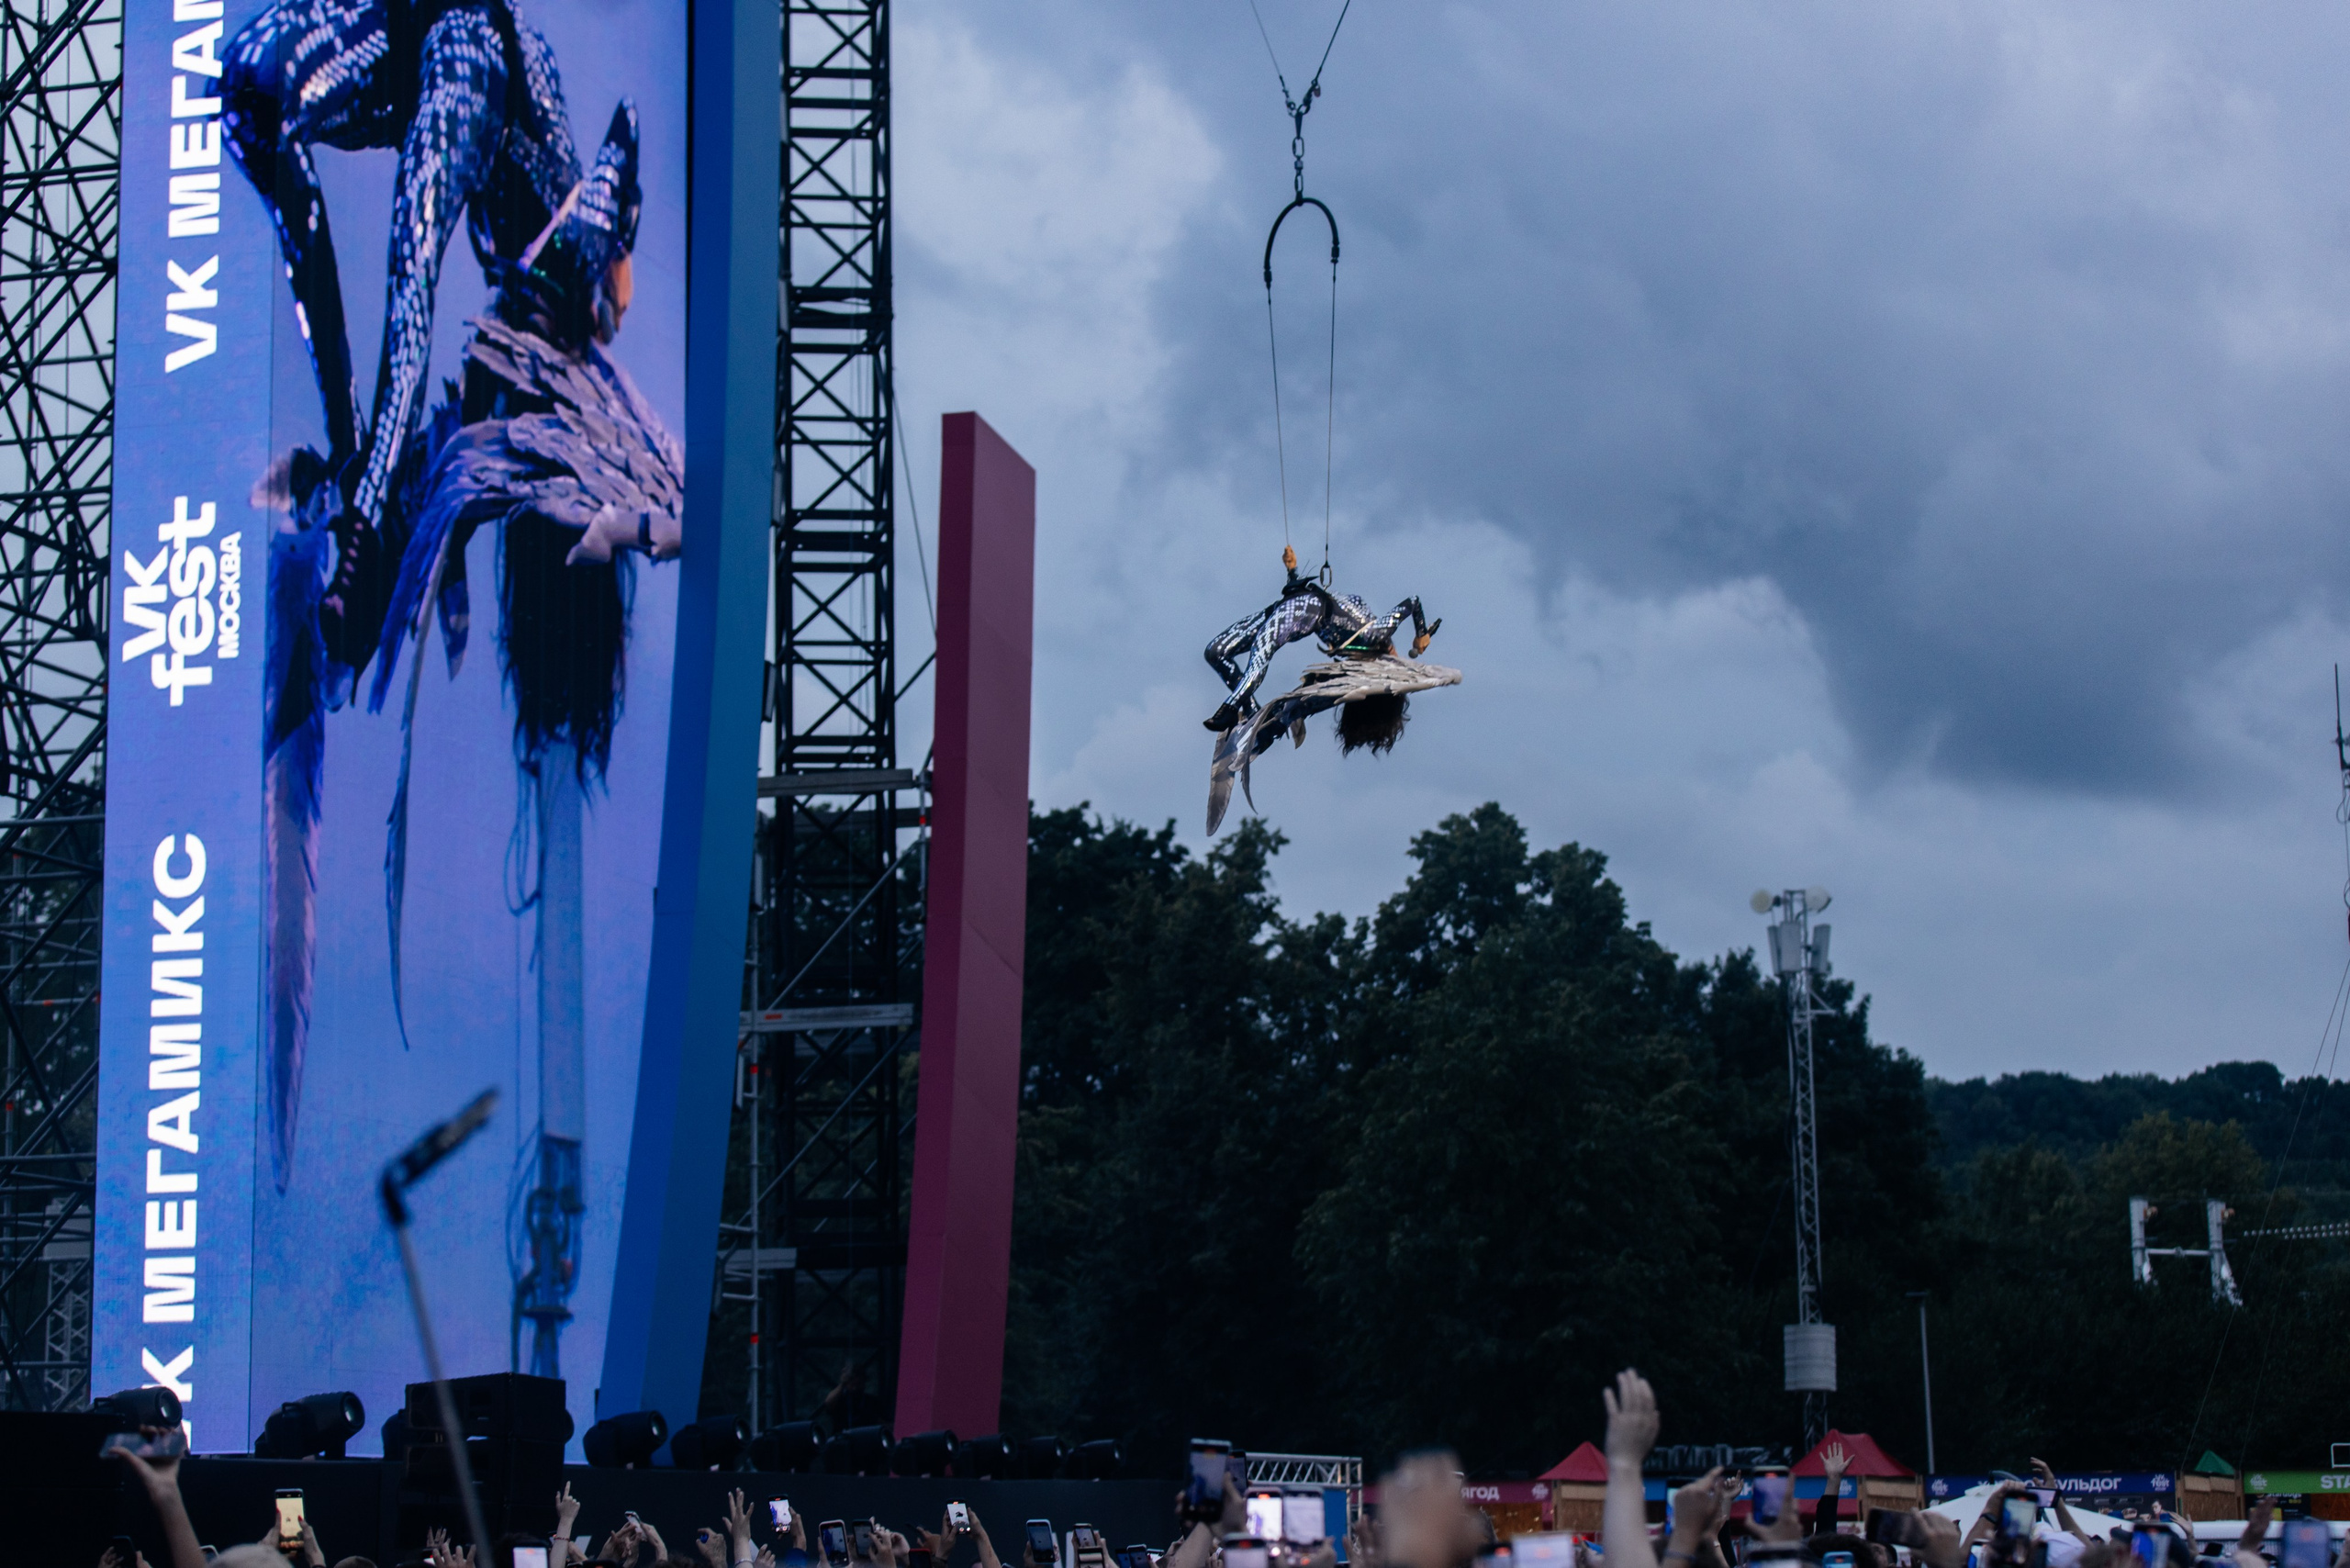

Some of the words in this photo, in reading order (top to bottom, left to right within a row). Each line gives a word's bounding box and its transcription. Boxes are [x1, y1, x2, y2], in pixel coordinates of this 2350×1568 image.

[164, 254, 218, 373] VK
[122, 545, 168, 662] VK
[151, 496, 217, 707] fest
[218, 531, 241, 658] МОСКВА
[142, 834, 207, 1323] МЕГАМИКС
[2053, 1477, 2122, 1493] УЛЬДОГ
